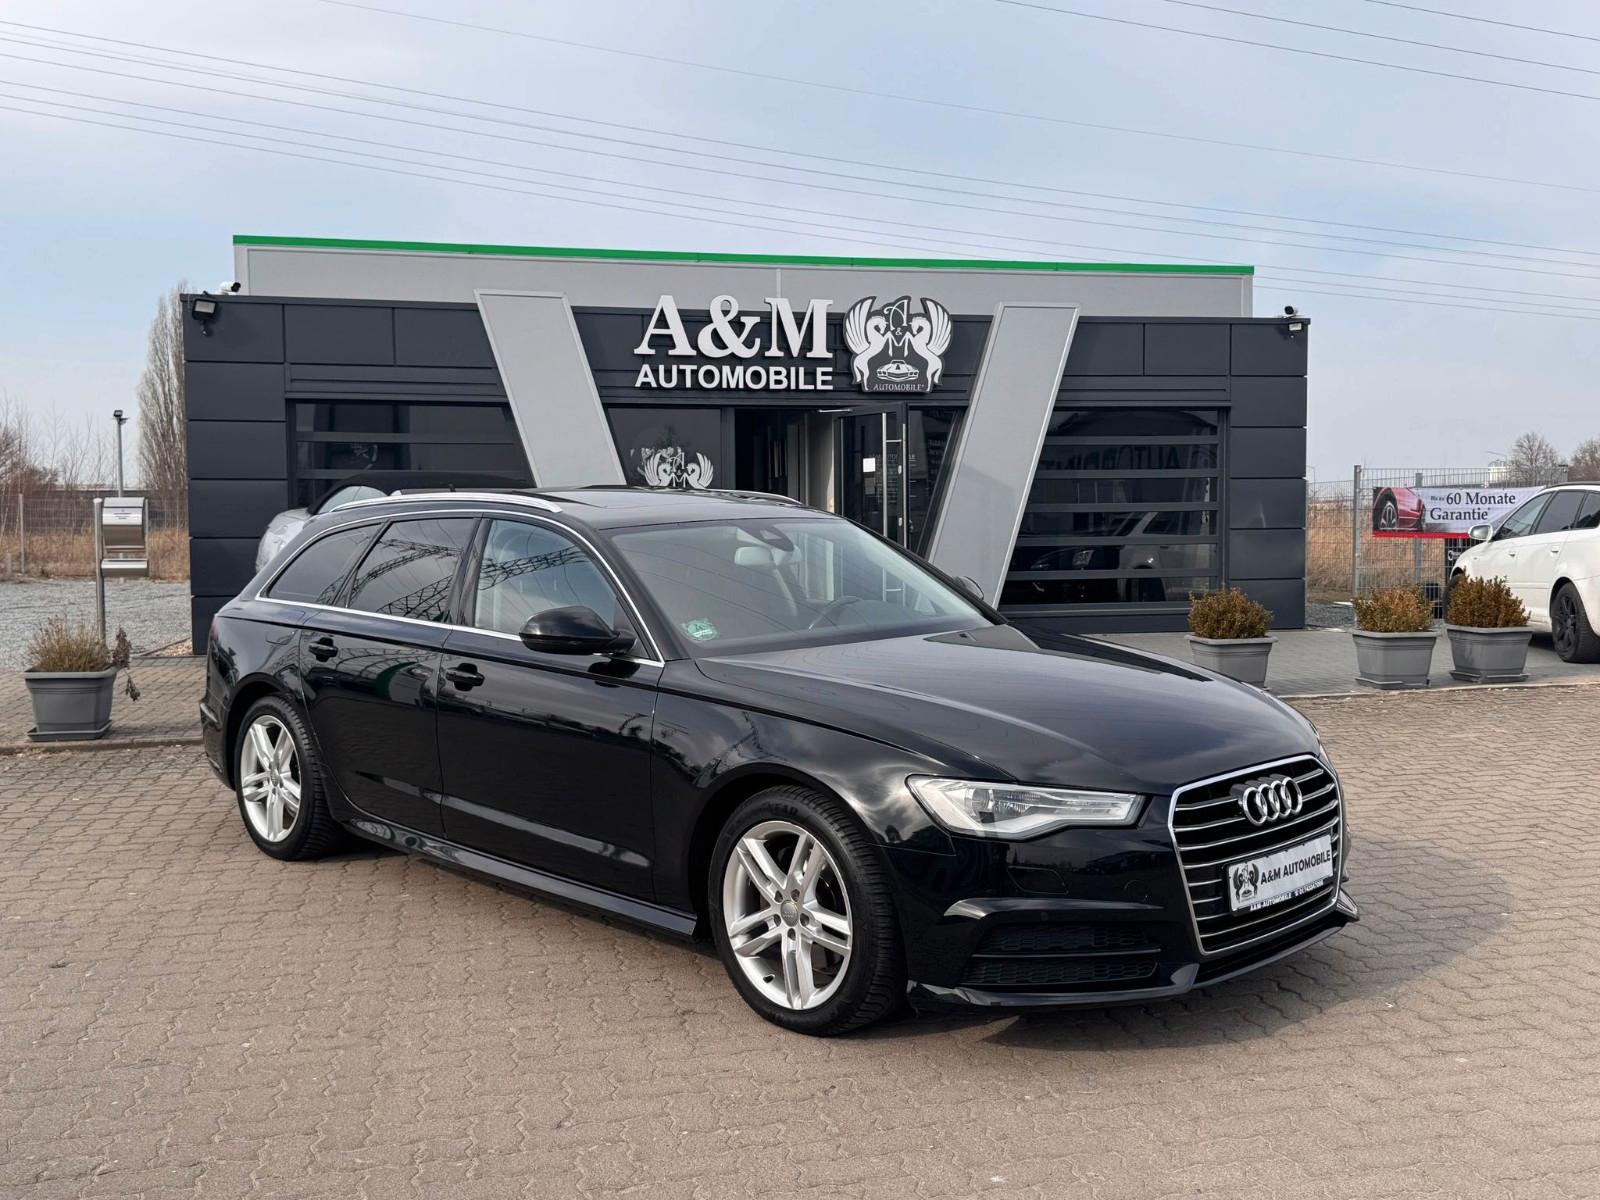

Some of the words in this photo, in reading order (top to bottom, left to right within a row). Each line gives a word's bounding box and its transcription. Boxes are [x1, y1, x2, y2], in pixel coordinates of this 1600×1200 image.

[634, 295, 834, 358] A&M
[634, 364, 834, 390] AUTOMOBILE
[1446, 492, 1462, 505] 60
[1465, 492, 1516, 505] Monate
[1261, 867, 1281, 885] A&M
[1283, 849, 1331, 877] AUTOMOBILE
